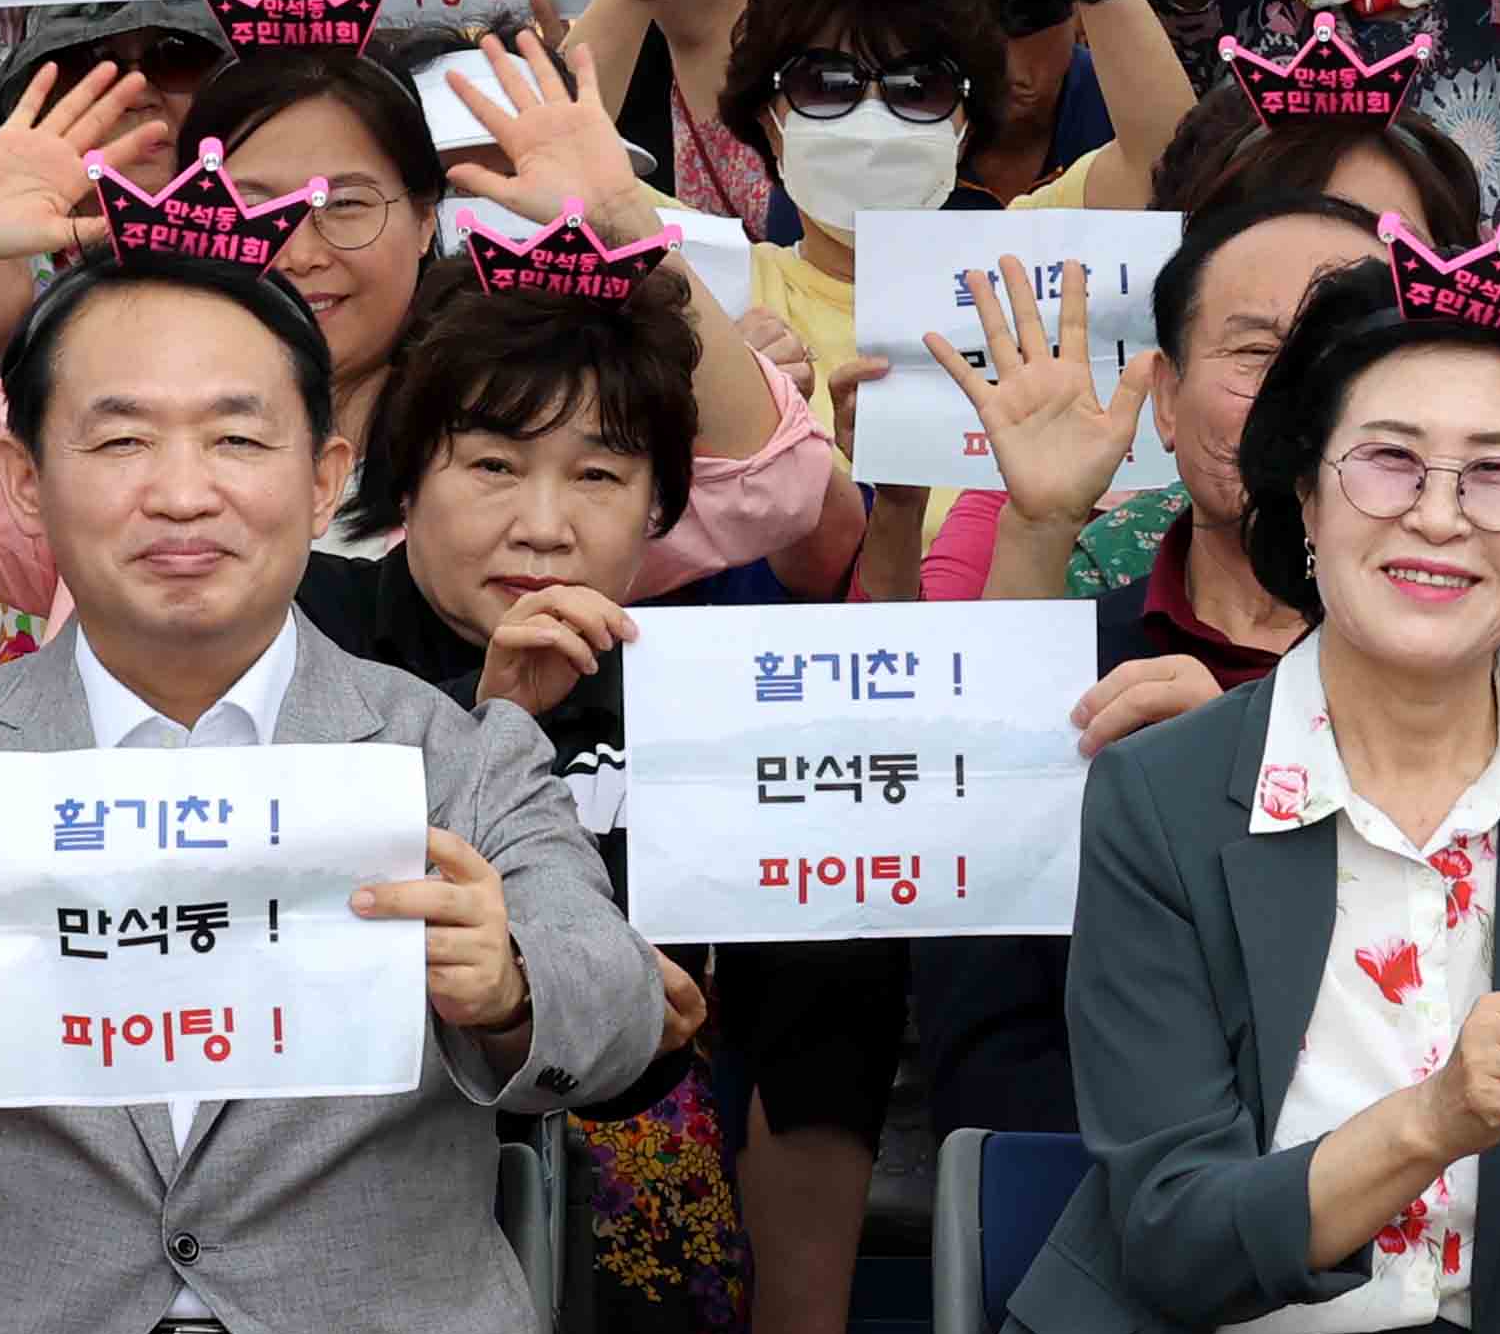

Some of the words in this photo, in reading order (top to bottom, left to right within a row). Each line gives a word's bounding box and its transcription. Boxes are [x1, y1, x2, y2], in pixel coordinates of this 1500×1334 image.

[232, 20, 360, 44] 주민자치회
[1295, 66, 1358, 86] 만석동
[1262, 90, 1390, 114] 주민자치회
[166, 197, 237, 231] 만석동
[122, 223, 270, 264] 주민자치회
